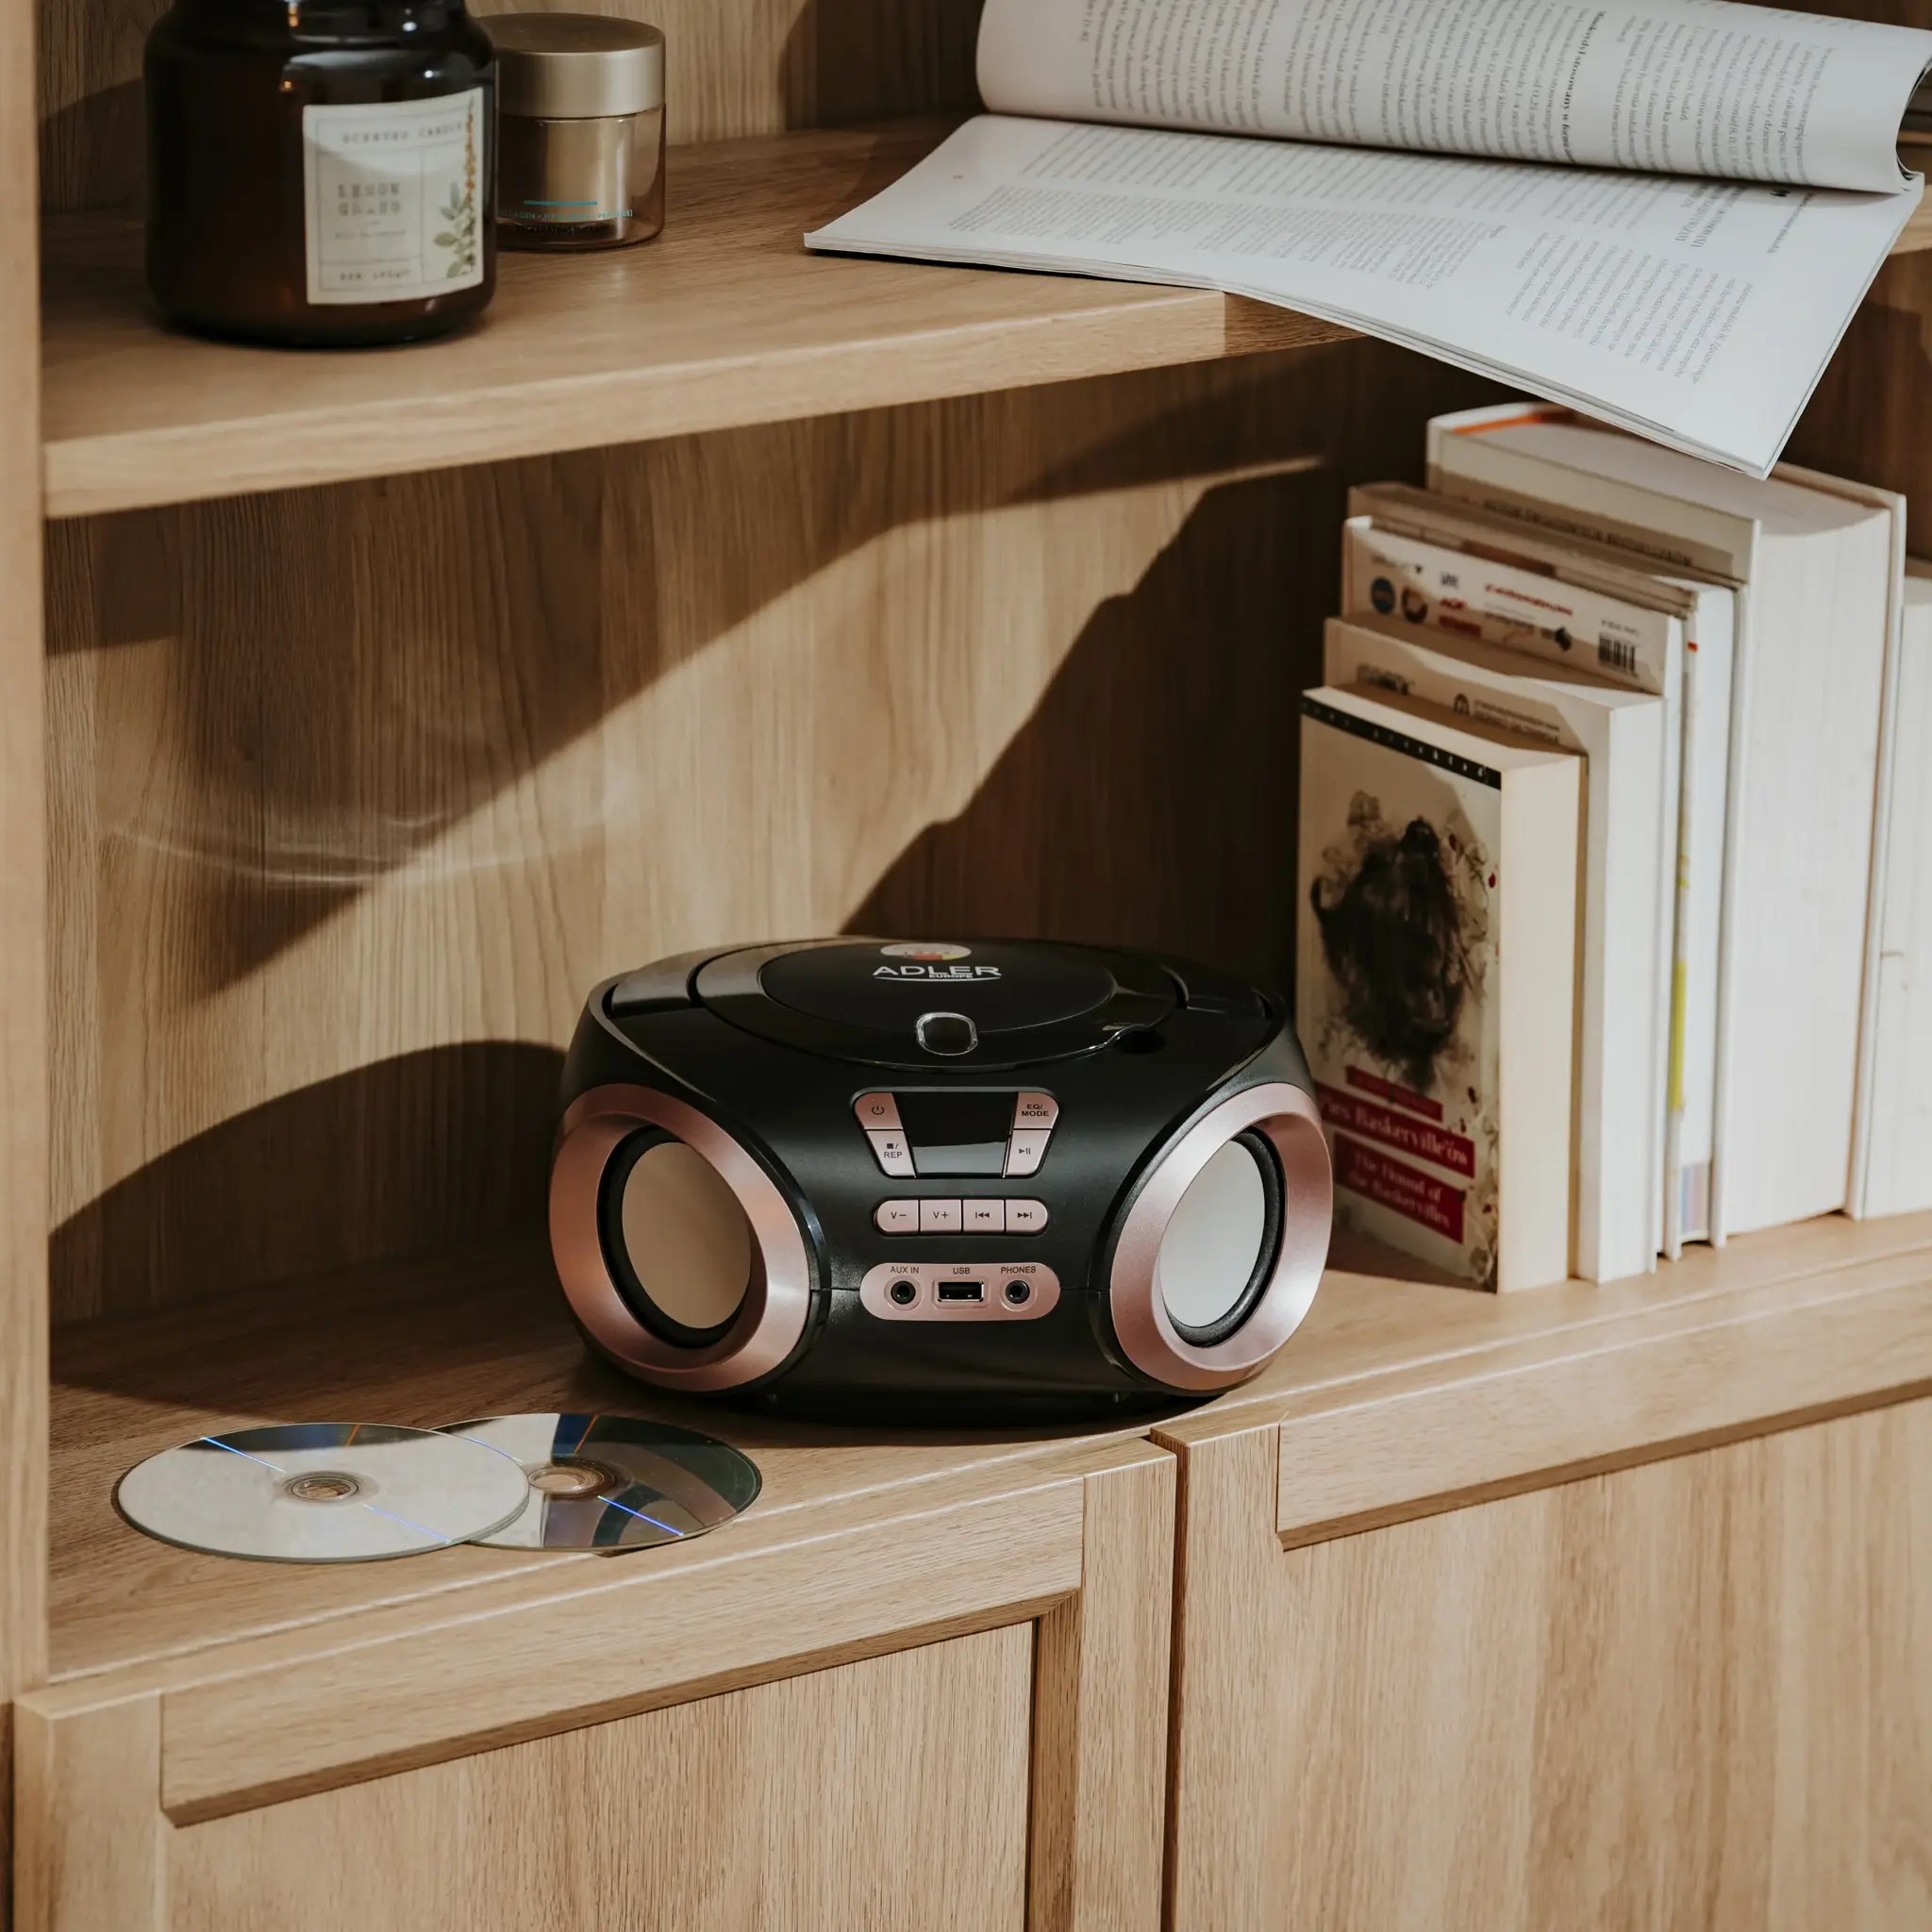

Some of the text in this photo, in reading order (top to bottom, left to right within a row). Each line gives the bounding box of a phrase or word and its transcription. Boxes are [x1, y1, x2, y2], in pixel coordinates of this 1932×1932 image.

[1560, 57, 1581, 109] stosowany
[873, 965, 1003, 976] ADLER
[1427, 1185, 1442, 1202] of
[1000, 1266, 1037, 1274] PHONES
